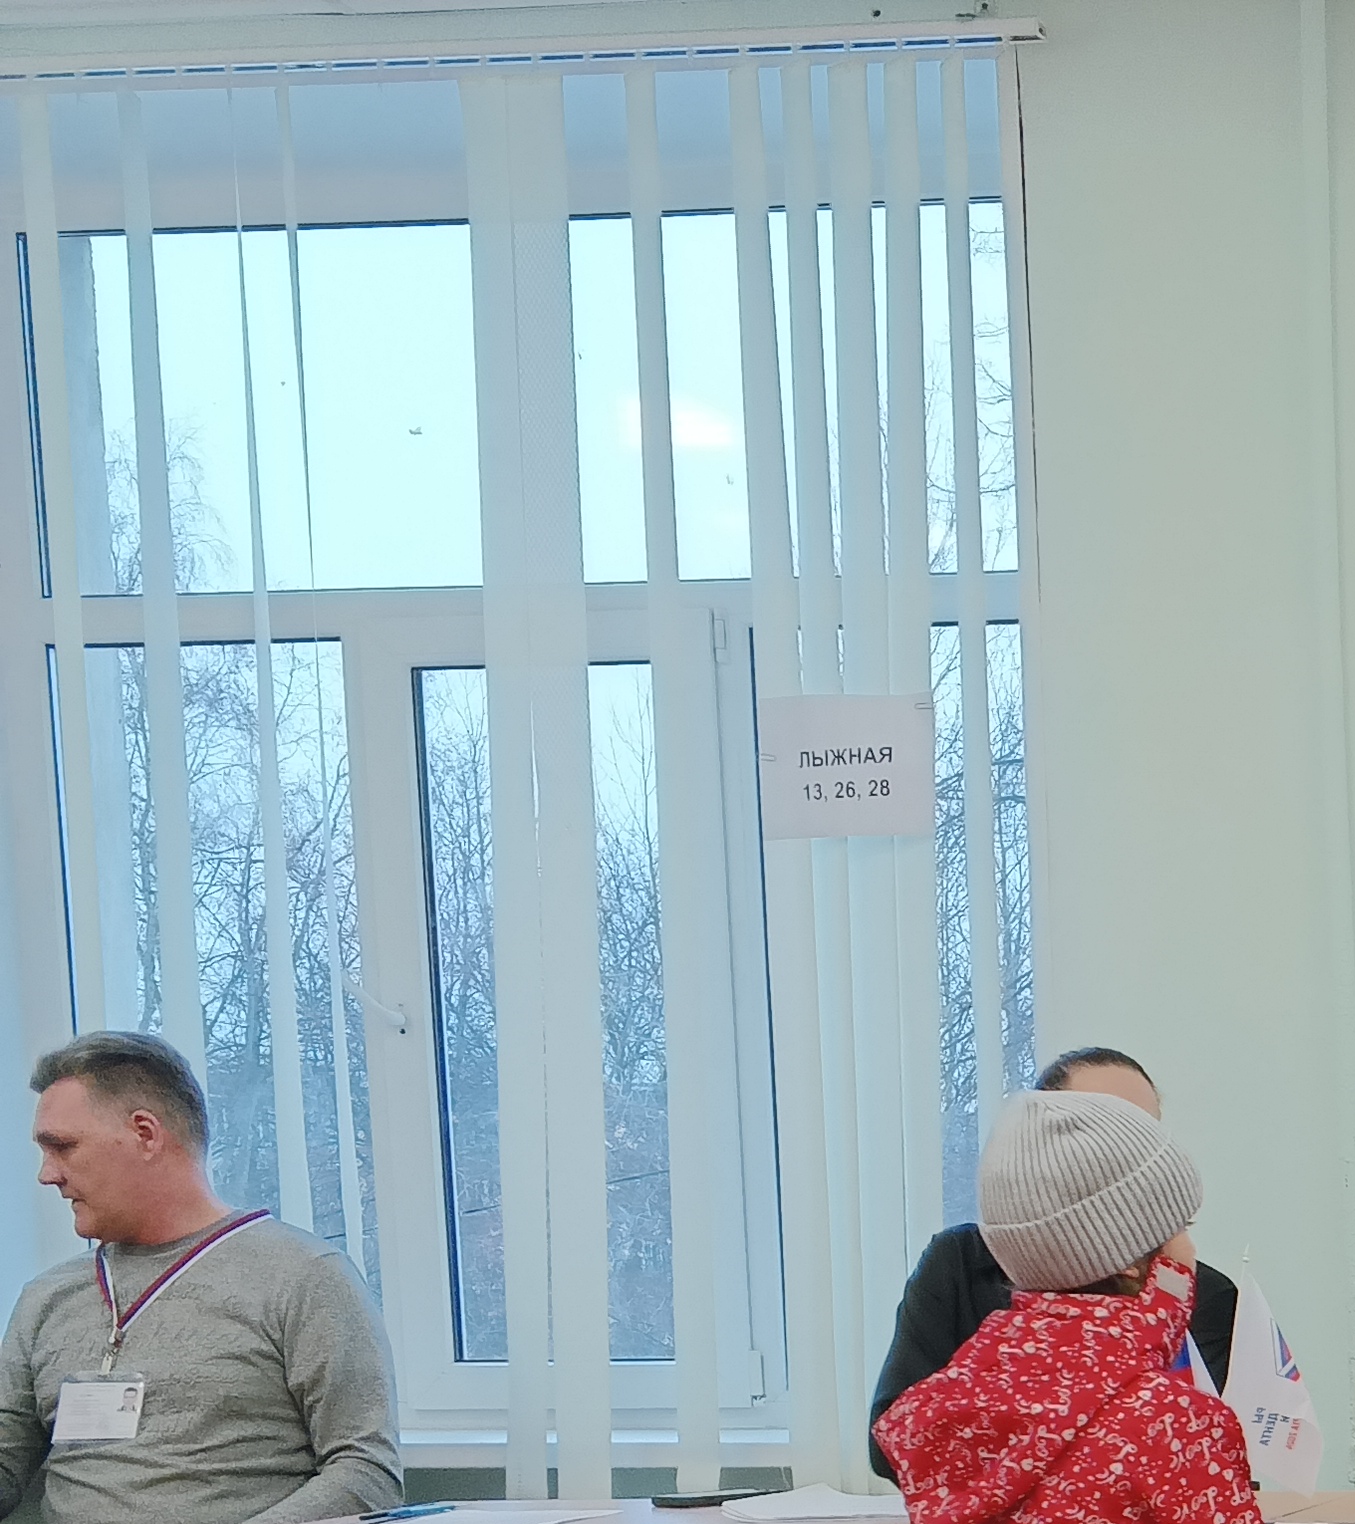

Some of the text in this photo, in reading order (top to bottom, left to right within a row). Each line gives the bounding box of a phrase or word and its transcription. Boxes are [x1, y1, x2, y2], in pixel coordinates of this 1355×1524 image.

[799, 747, 893, 768] ЛЫЖНАЯ
[803, 779, 891, 802] 13, 26, 28
